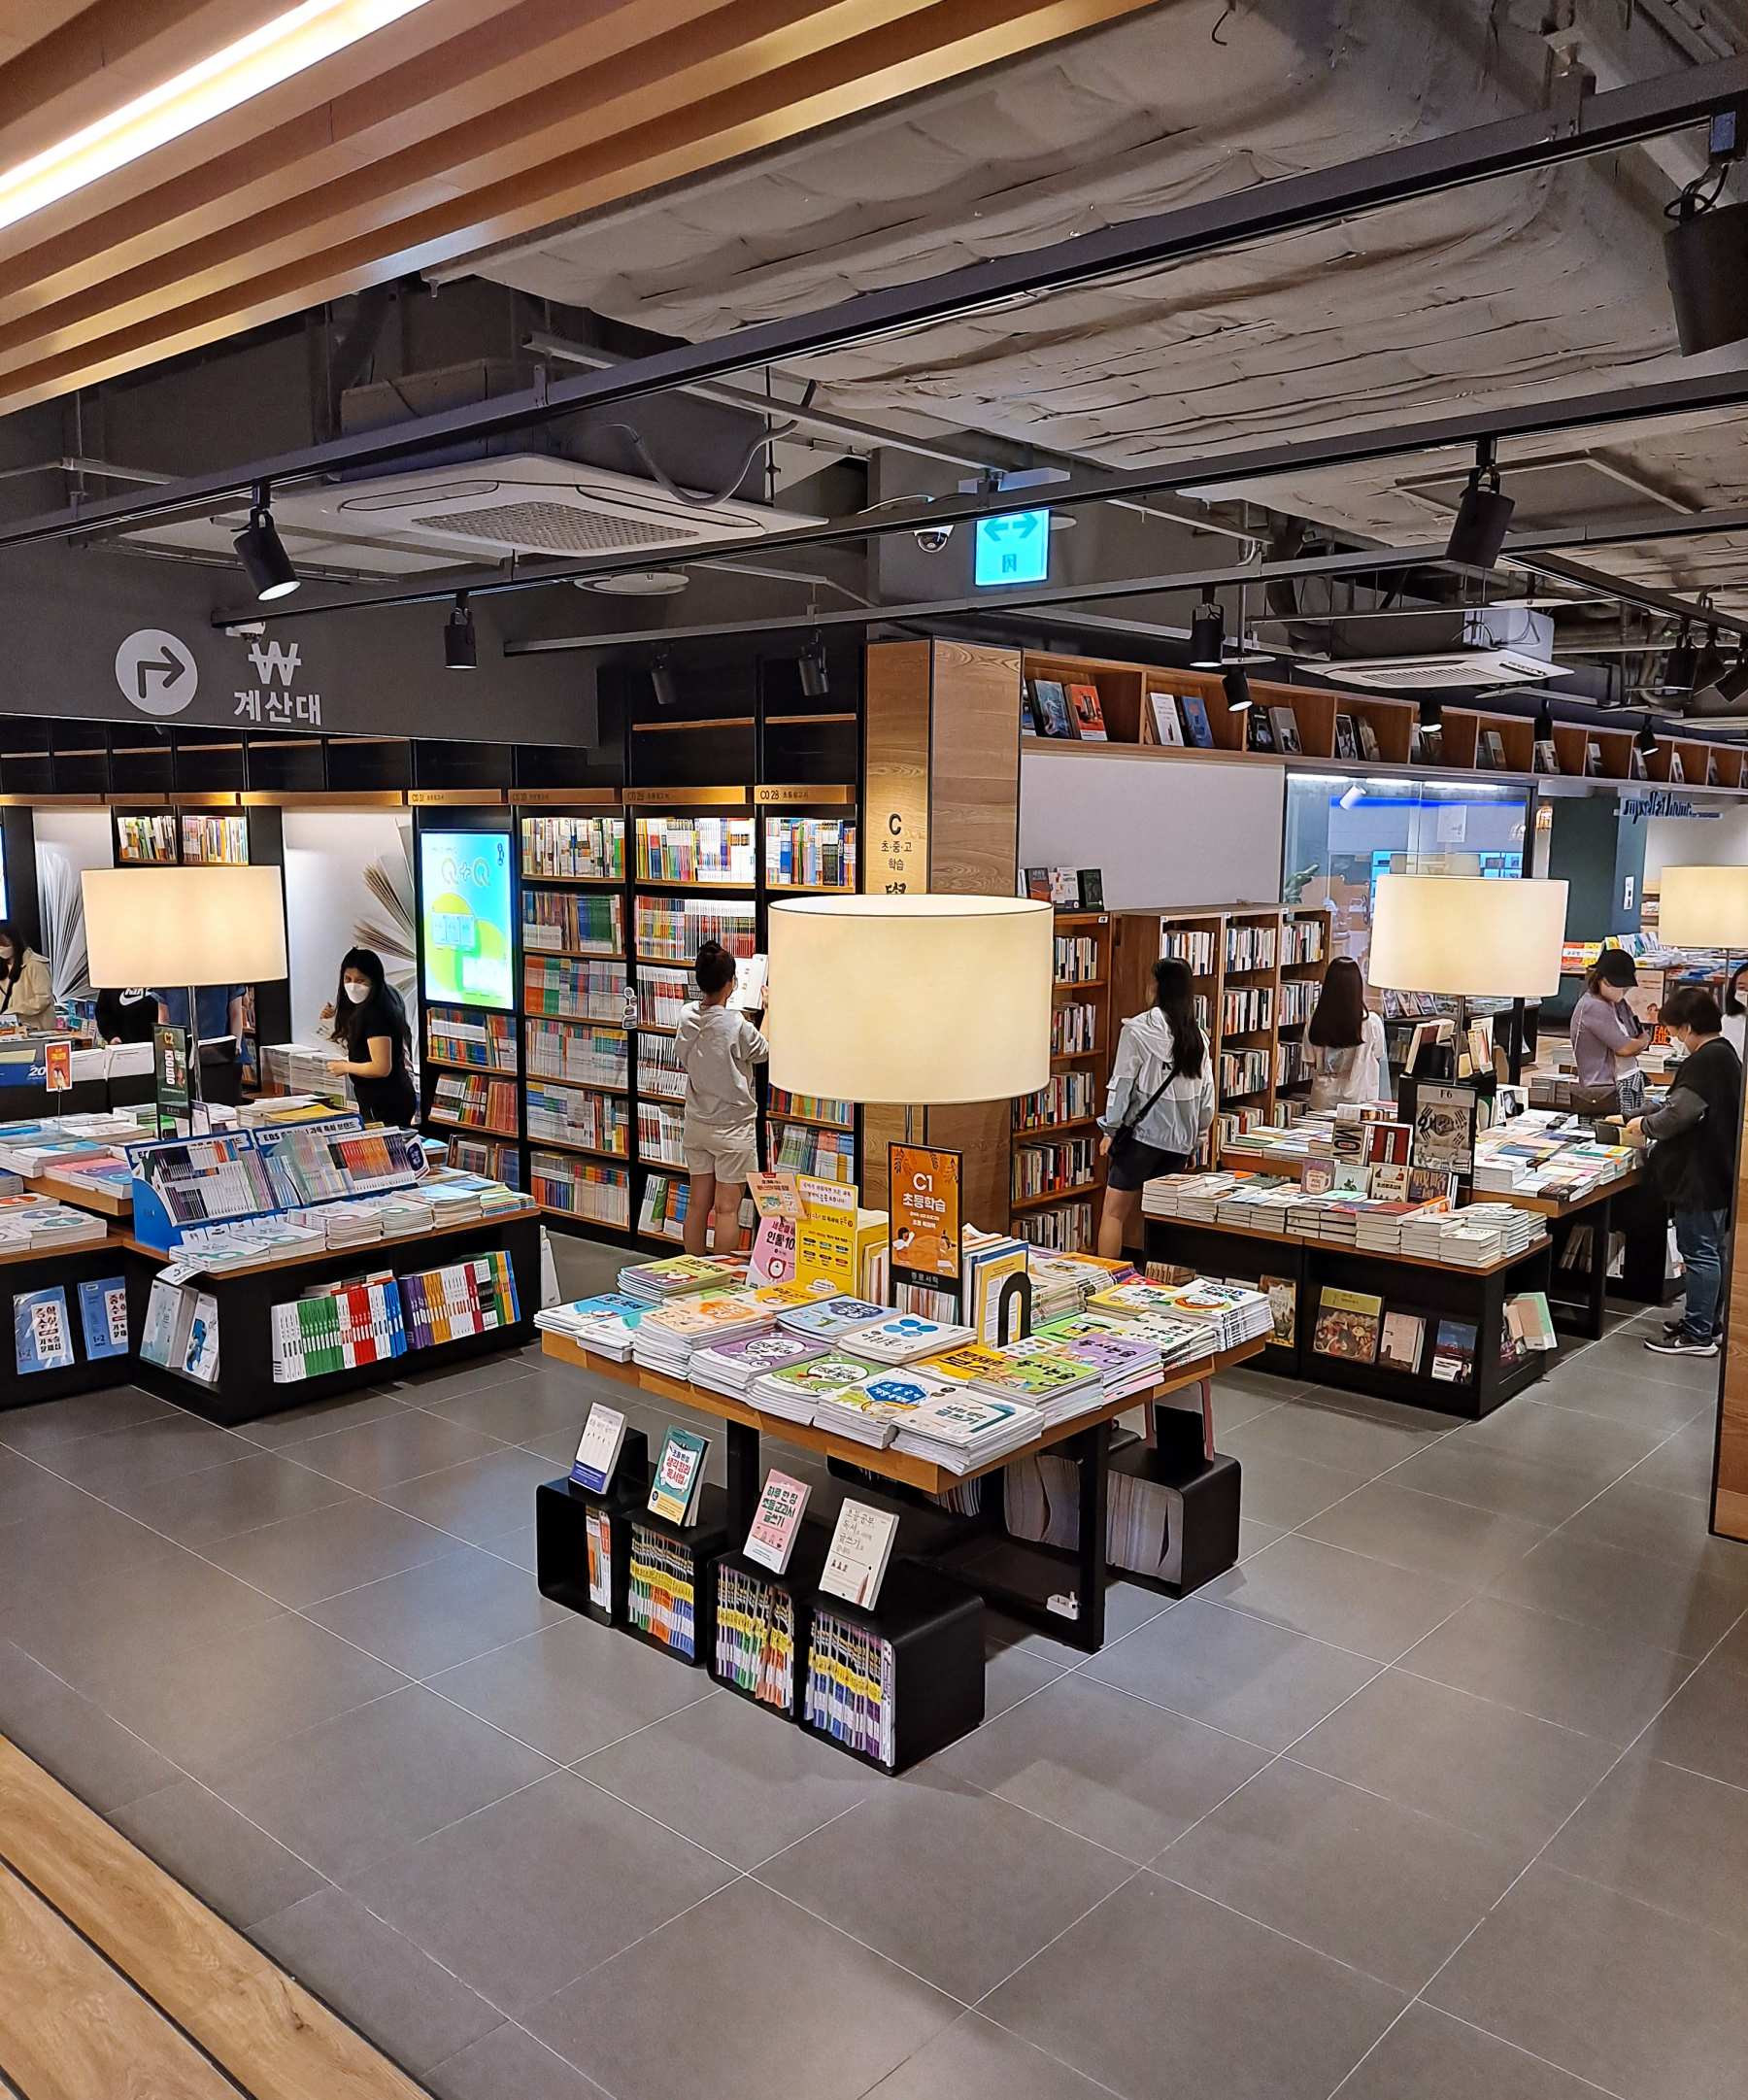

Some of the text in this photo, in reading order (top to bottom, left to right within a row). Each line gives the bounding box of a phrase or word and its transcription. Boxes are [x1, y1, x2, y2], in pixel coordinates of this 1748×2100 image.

[233, 690, 322, 726] 계산대
[889, 813, 901, 835] C
[888, 858, 904, 871] 학습
[1440, 1089, 1453, 1099] F6
[913, 1172, 933, 1192] C1
[902, 1192, 947, 1213] 초등학습
